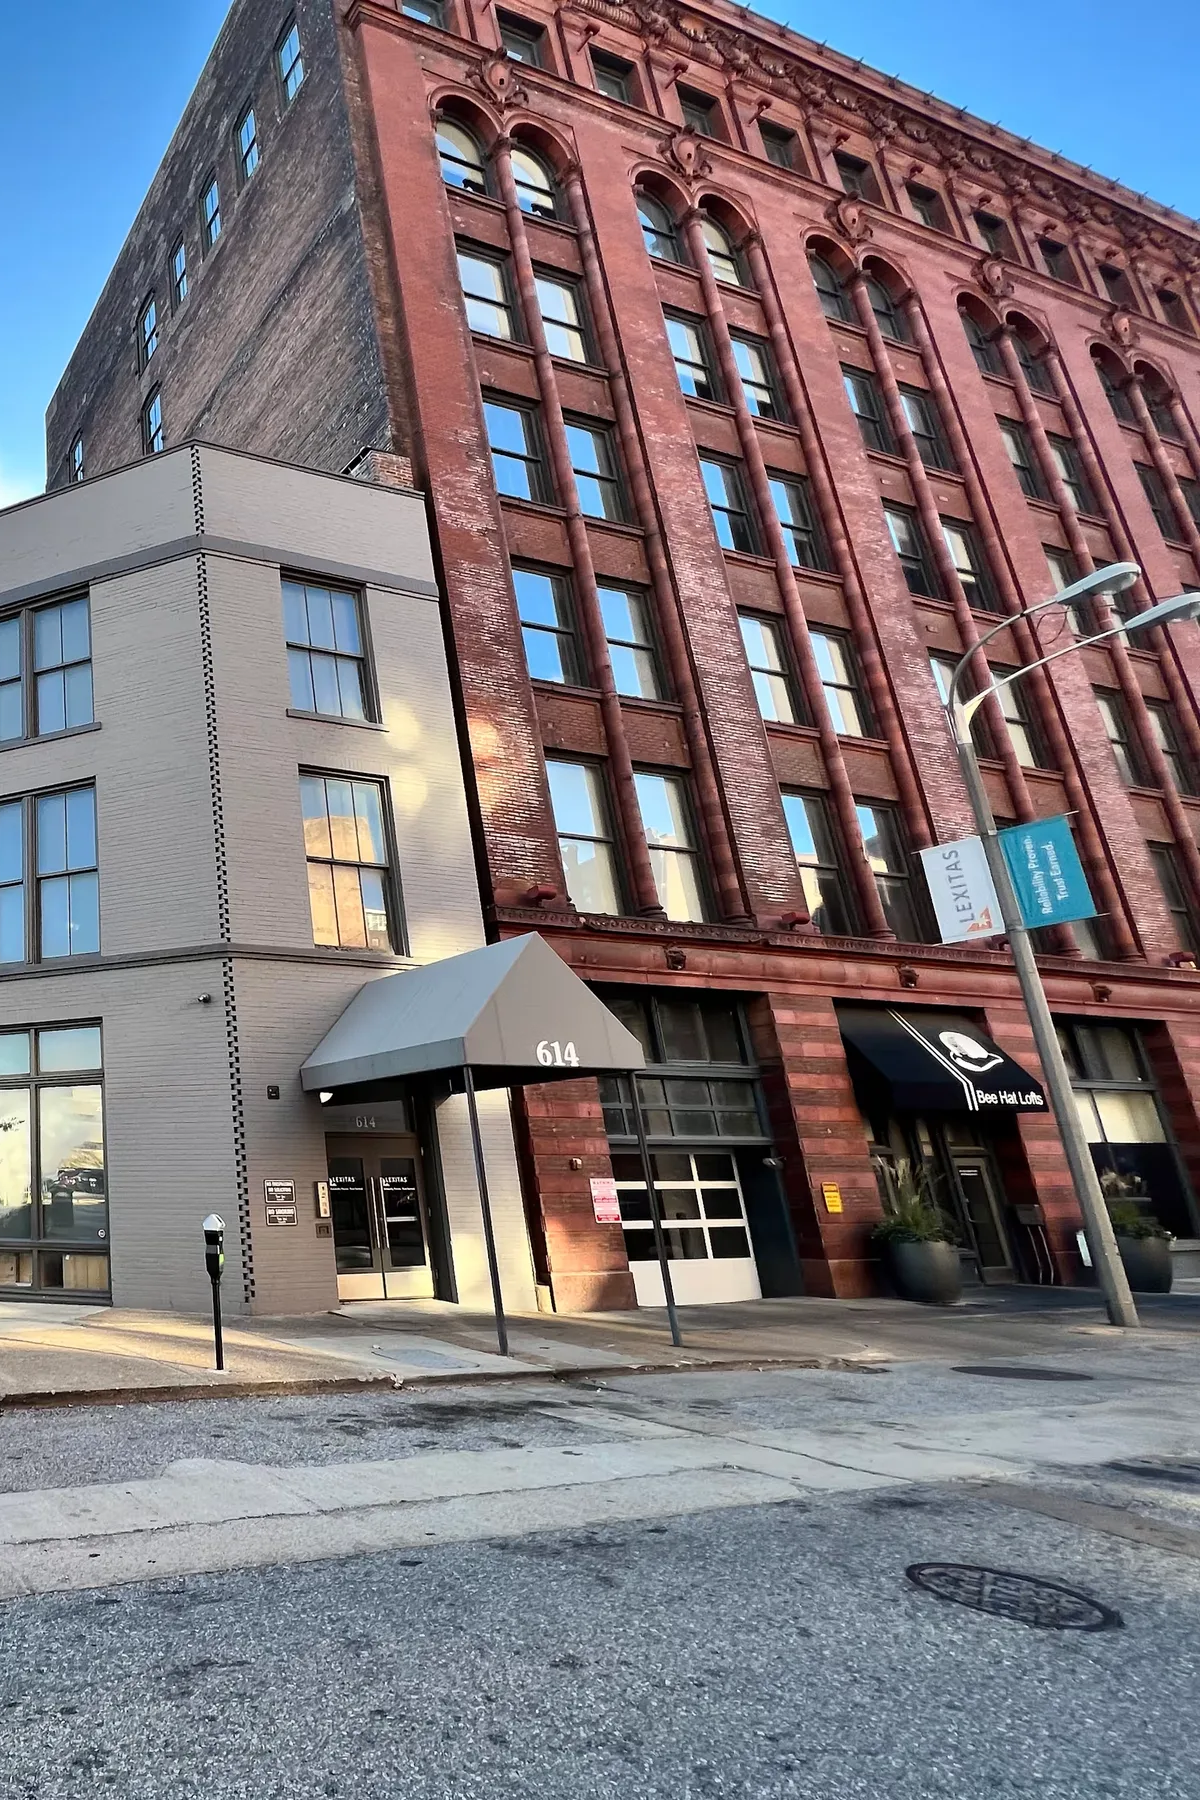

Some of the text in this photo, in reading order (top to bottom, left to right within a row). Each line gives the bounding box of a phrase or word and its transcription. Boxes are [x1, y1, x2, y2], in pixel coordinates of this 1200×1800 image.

[942, 849, 975, 924] LEXITAS
[1024, 835, 1053, 915] Reliability Proven.
[1040, 840, 1069, 901] Trust Earned.
[536, 1040, 580, 1067] 614
[976, 1089, 1043, 1106] Bee Hat Lofts
[355, 1115, 376, 1128] 614
